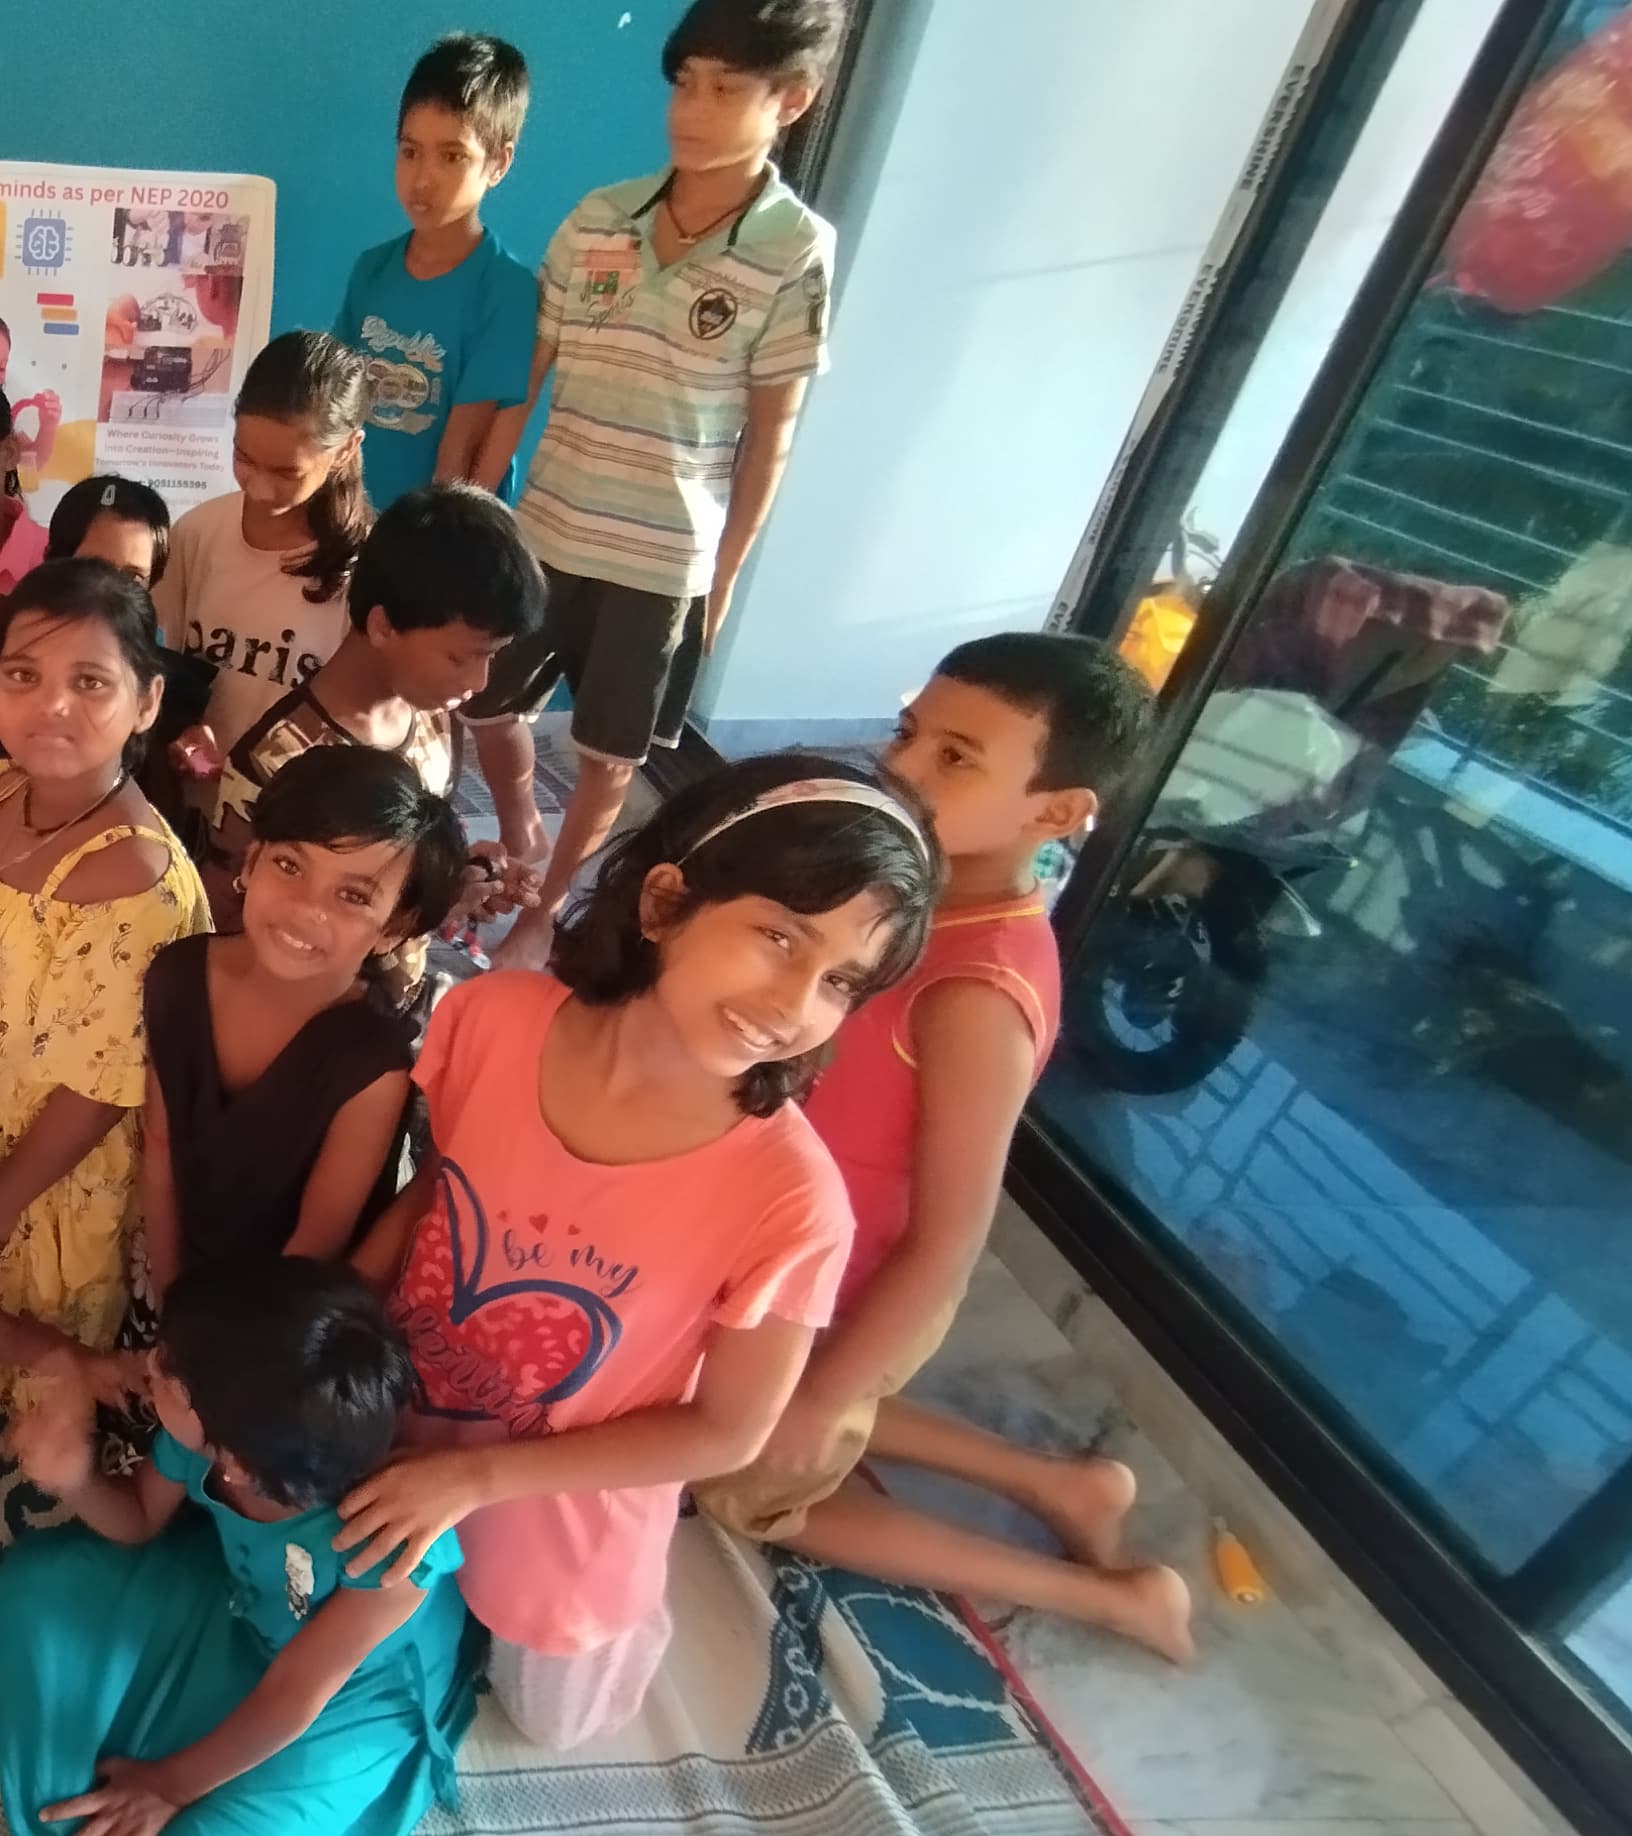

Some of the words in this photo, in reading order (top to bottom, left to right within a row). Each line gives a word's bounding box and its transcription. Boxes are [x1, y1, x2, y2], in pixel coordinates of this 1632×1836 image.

[62, 186, 84, 201] as
[90, 189, 124, 205] per
[131, 186, 172, 206] NEP
[176, 190, 228, 208] 2020
[107, 429, 139, 439] Where
[141, 430, 186, 444] Curiosity
[503, 1228, 555, 1271] be
[569, 1244, 644, 1298] my
